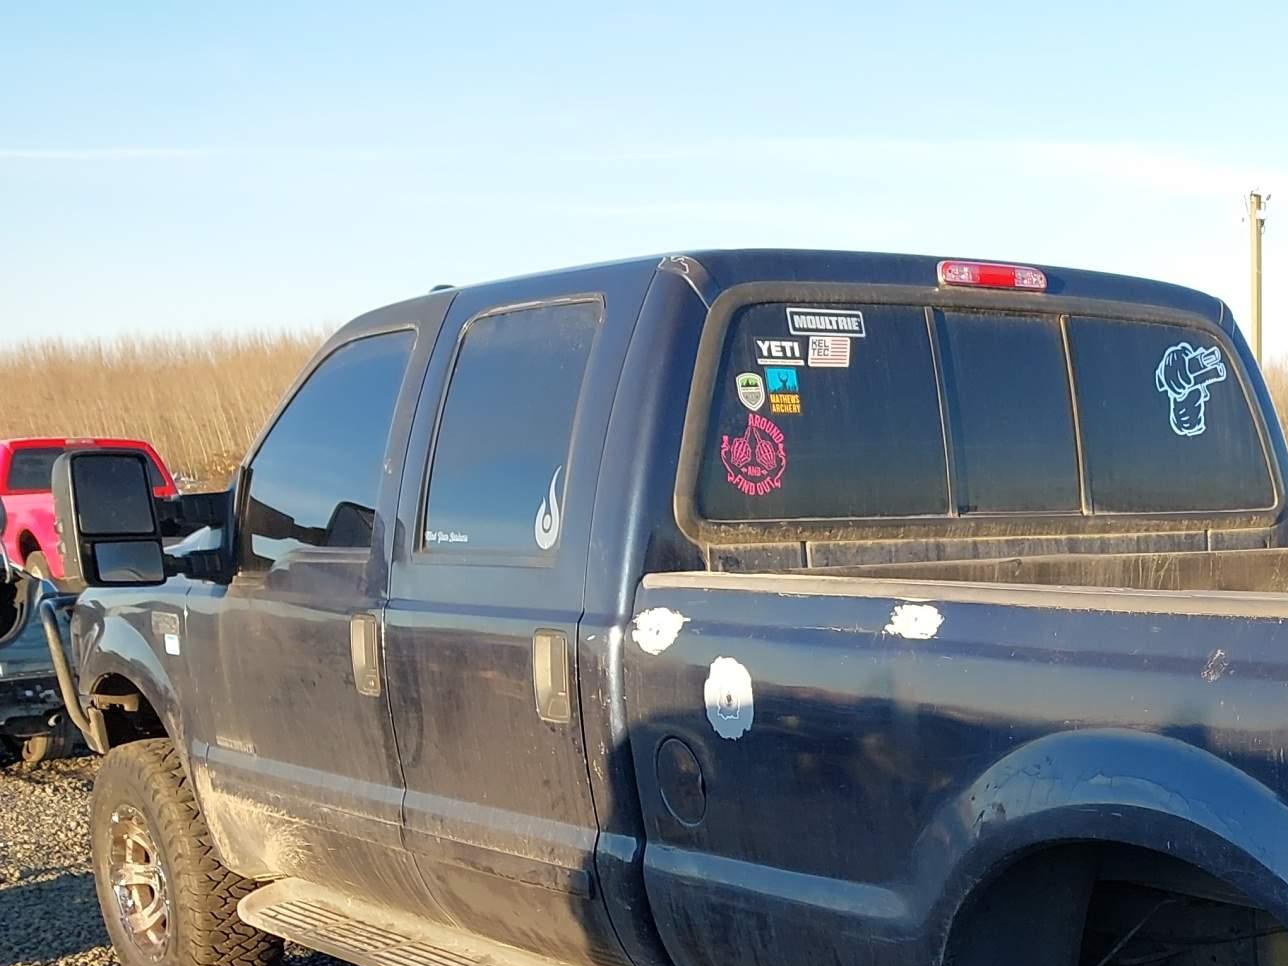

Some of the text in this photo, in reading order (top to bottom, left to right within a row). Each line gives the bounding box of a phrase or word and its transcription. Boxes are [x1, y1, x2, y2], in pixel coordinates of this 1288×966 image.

[793, 314, 861, 330] MOULTRIE
[811, 338, 830, 348] KEL
[756, 340, 801, 358] YETI
[811, 348, 830, 357] TEC
[770, 394, 800, 403] MATHEWS
[771, 403, 801, 414] ARCHERY
[748, 413, 784, 445] AROUND
[747, 466, 762, 477] AND
[733, 474, 776, 495] FIND OUT
